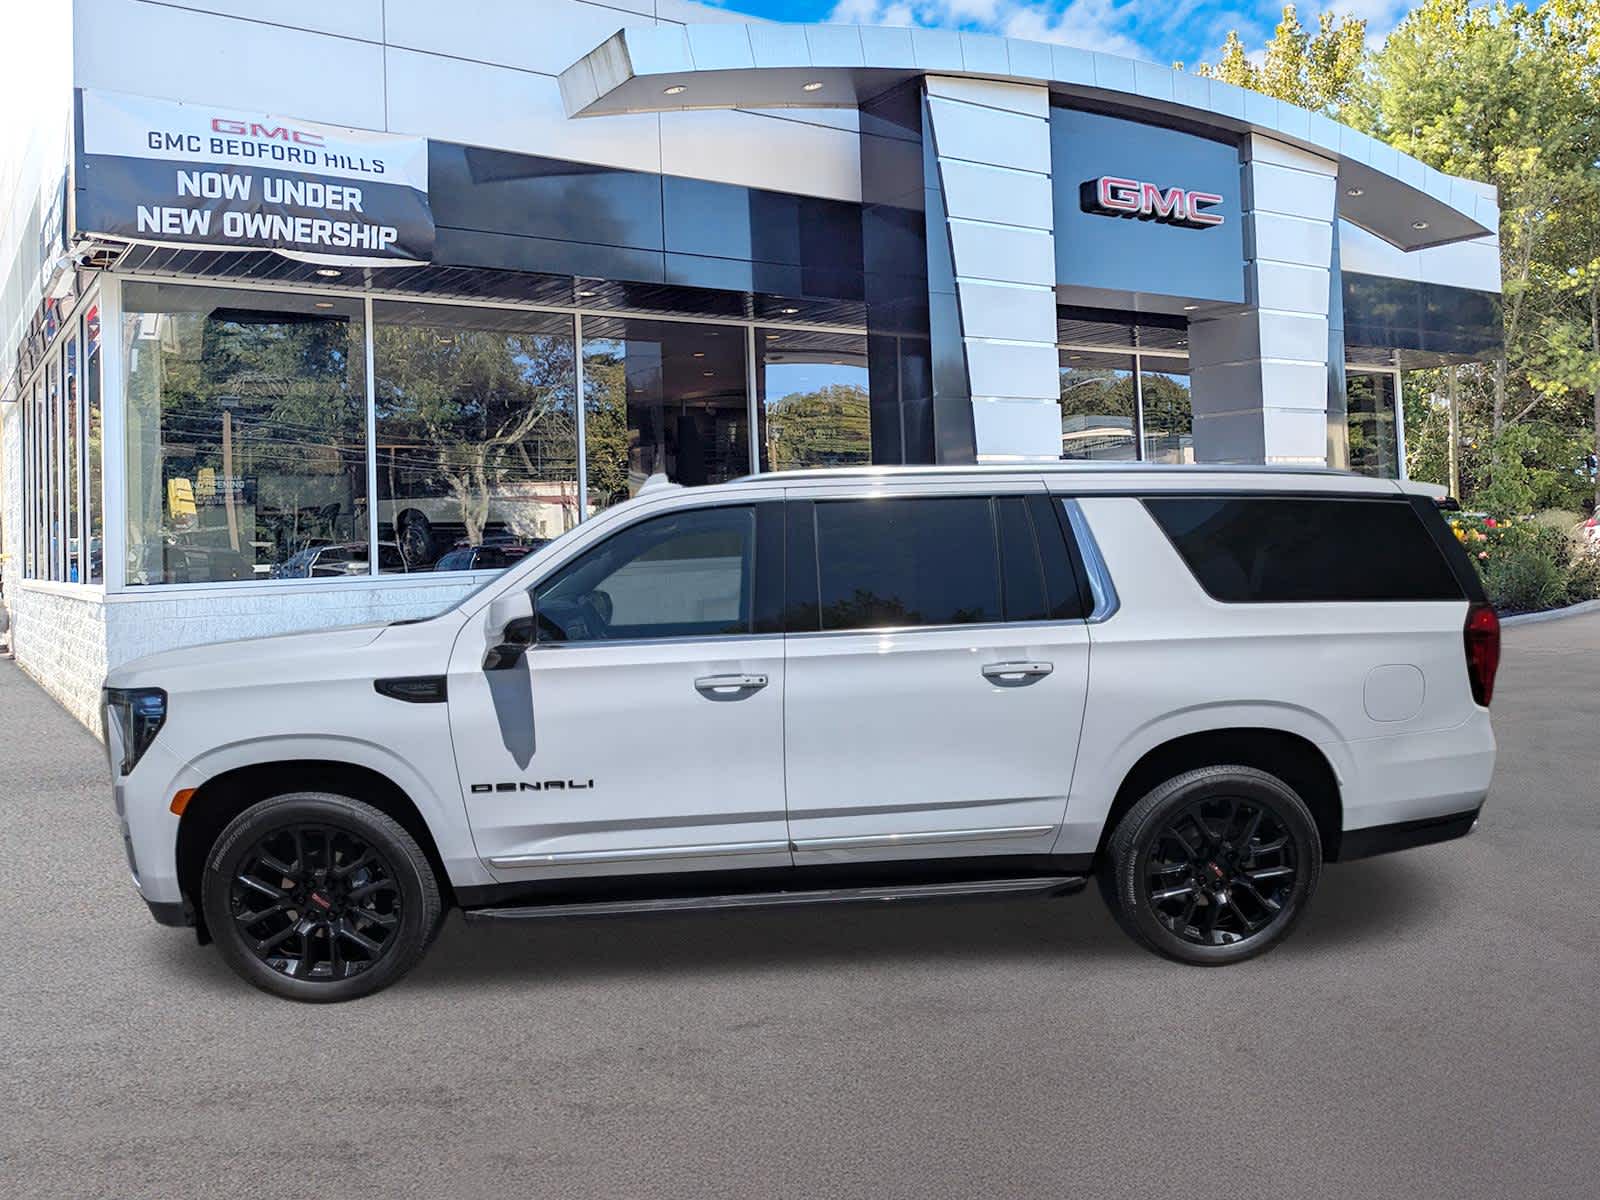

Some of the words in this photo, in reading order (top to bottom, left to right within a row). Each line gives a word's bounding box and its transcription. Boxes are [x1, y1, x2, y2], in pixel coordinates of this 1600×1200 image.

[148, 131, 201, 153] GMC
[210, 138, 317, 166] BEDFORD
[324, 153, 385, 174] HILLS
[211, 118, 326, 148] GMC
[177, 170, 252, 201] NOW
[263, 177, 364, 213] UNDER
[1097, 175, 1225, 225] GMC
[137, 205, 212, 236] NEW
[223, 211, 398, 250] OWNERSHIP
[470, 779, 594, 793] DENALI
